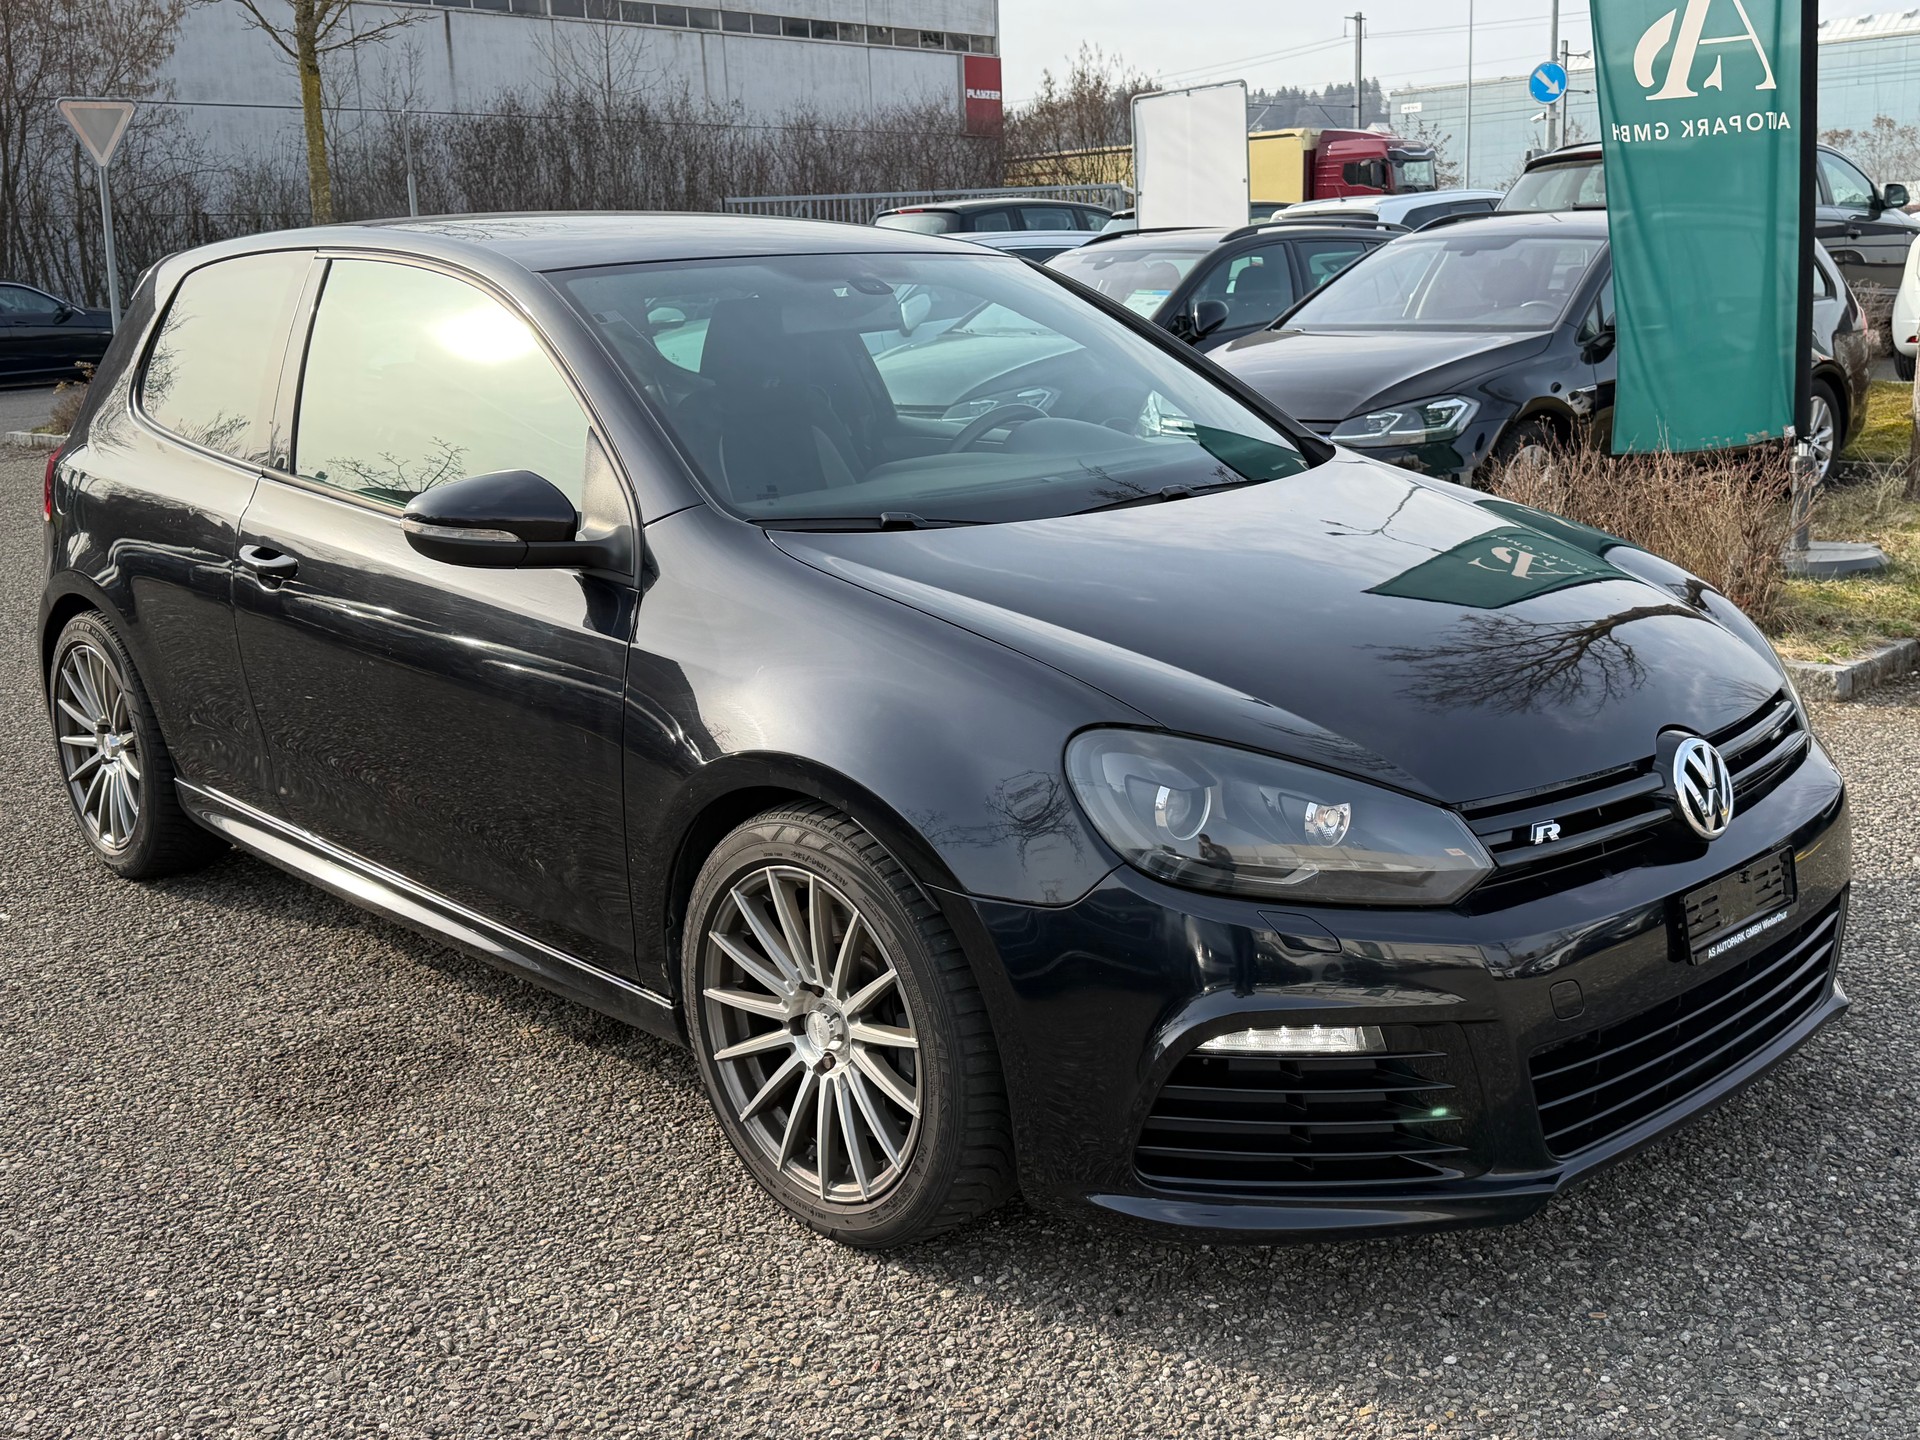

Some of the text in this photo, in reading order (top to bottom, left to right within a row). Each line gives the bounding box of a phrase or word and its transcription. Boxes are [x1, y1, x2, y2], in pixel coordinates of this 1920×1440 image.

[1530, 820, 1561, 845] R
[1708, 946, 1716, 959] AS
[1716, 930, 1746, 955] AUTOPARK
